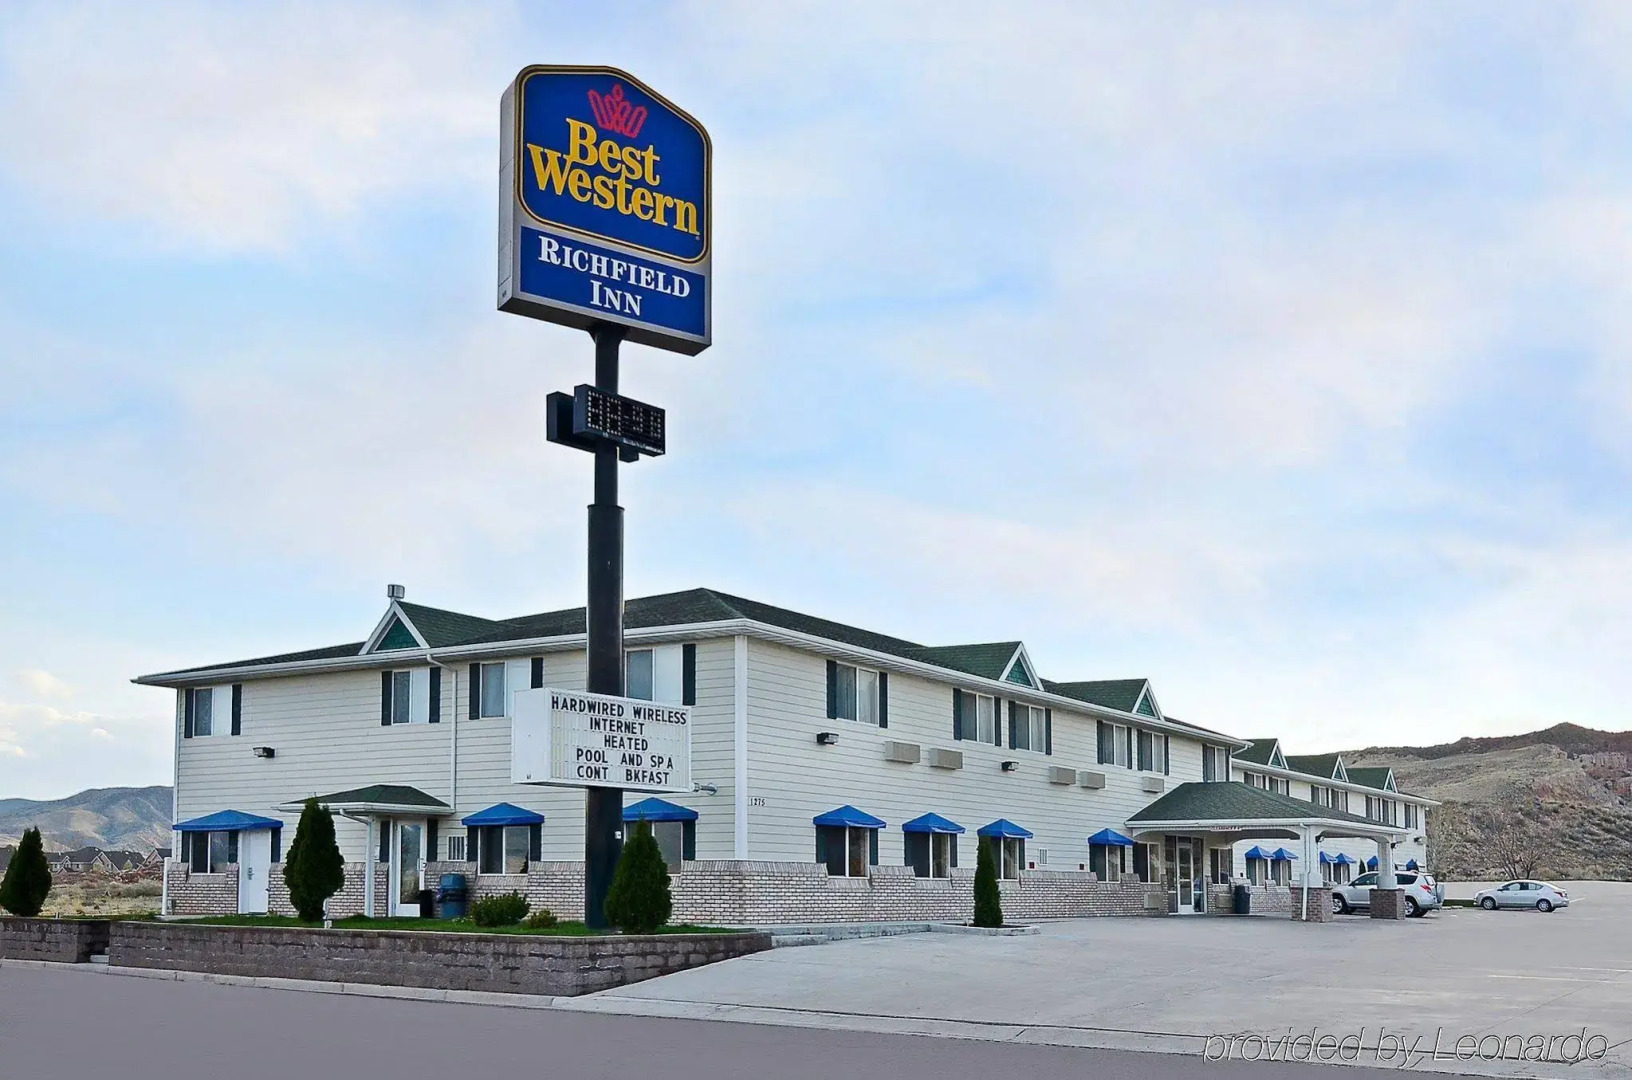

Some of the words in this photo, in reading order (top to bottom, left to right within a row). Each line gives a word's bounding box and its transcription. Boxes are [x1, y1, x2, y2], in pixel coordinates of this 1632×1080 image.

[566, 117, 660, 186] Best
[527, 143, 700, 236] Western
[538, 235, 691, 298] RICHFIELD
[590, 279, 643, 316] INN
[551, 695, 624, 717] HARDWIRED
[633, 706, 687, 725] WIRELESS
[589, 717, 645, 735] INTERNET
[604, 734, 648, 751] HEATED
[576, 748, 608, 764] POOL
[620, 752, 643, 767] AND
[650, 755, 674, 770] SPA
[577, 765, 609, 780] CONT
[625, 768, 669, 784] BKFAST
[750, 797, 766, 807] 1275
